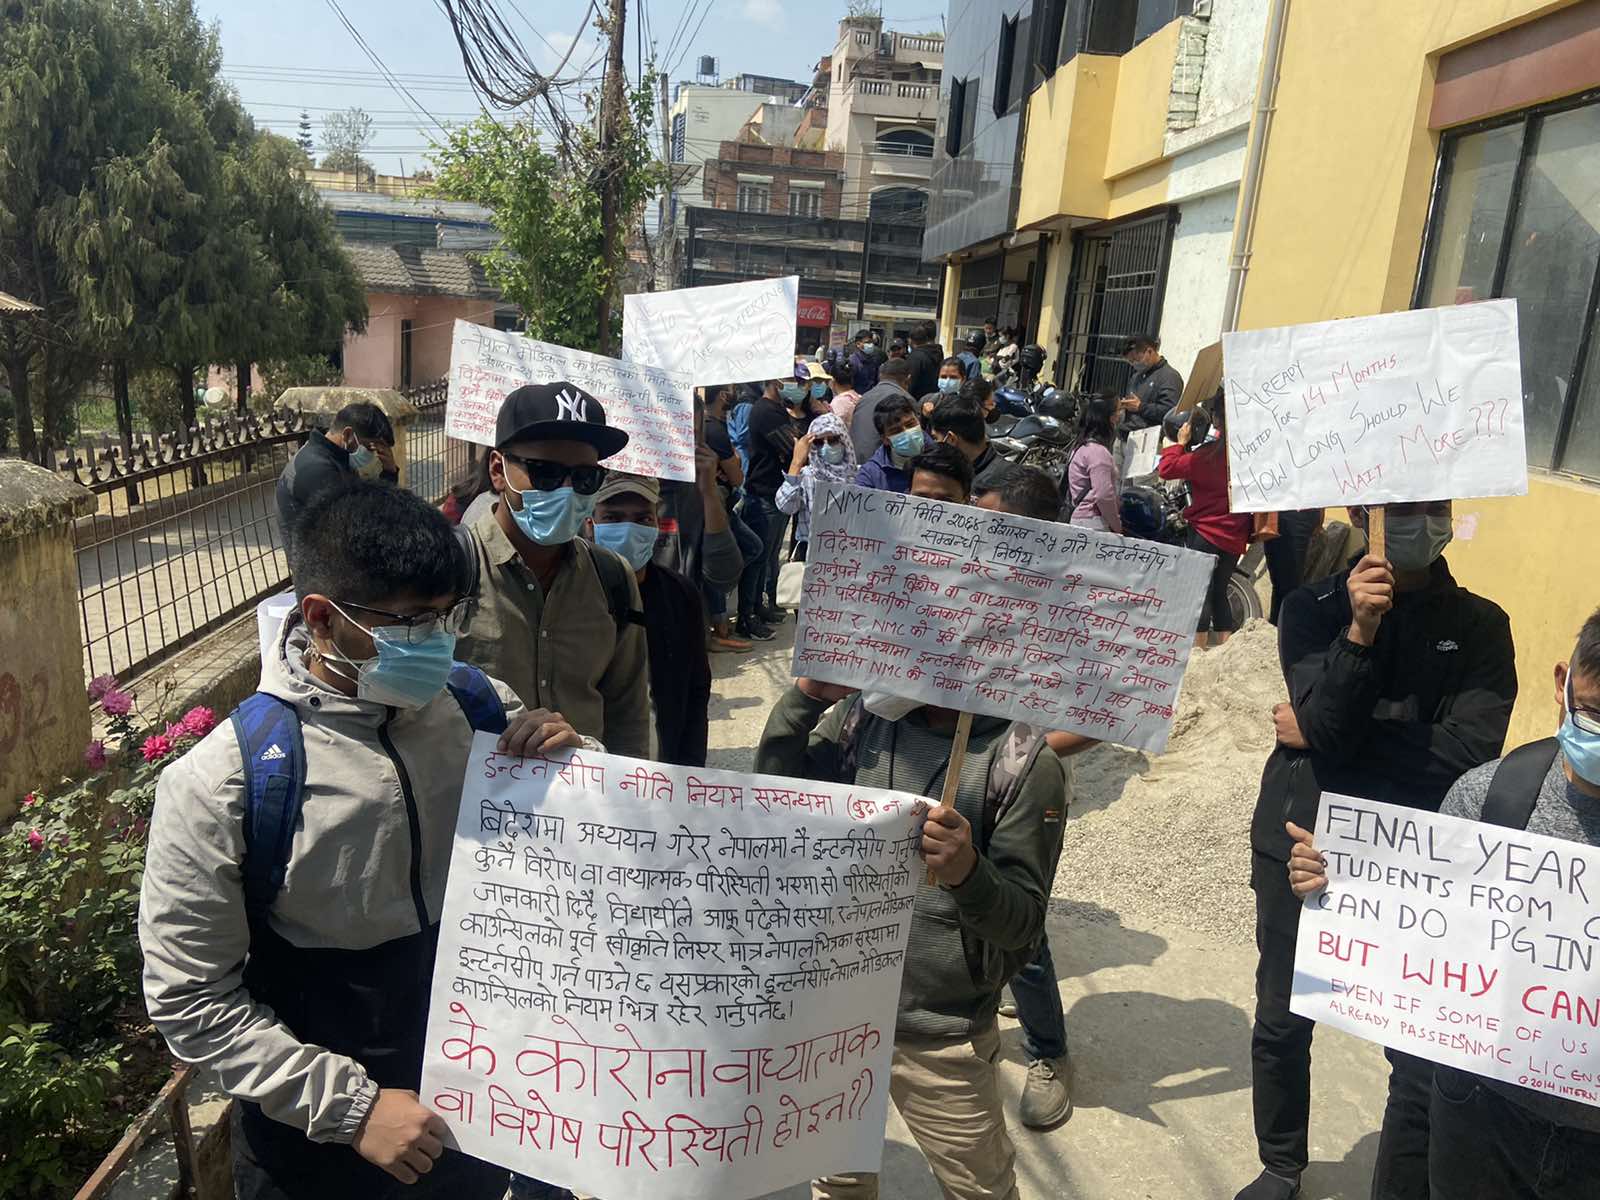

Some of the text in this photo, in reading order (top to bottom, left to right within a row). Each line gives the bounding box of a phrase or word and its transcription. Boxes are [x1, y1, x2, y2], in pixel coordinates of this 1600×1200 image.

[555, 389, 587, 422] NY
[1229, 360, 1305, 418] ALREADY
[1270, 406, 1299, 432] FOR
[1302, 387, 1327, 415] 14
[1331, 354, 1397, 391] MONTHS
[1237, 378, 1461, 503] HOW LONG SHOULD WE
[1332, 460, 1383, 495] WAIT
[824, 489, 876, 516] NMC
[885, 495, 911, 517] को
[913, 503, 947, 524] मिति
[946, 512, 987, 533] २०६४
[1061, 533, 1091, 554] गते
[816, 528, 886, 554] विदेशमा
[891, 545, 957, 570] अध्ययन
[960, 557, 1000, 581] गरेर
[1004, 565, 1056, 589] नेपालमा
[1086, 584, 1167, 616] इन्टर्नसीप
[866, 565, 899, 590] कुनै
[944, 585, 969, 600] वा
[804, 577, 832, 600] सो
[915, 604, 977, 632] जानकारी
[850, 613, 868, 631] र
[872, 619, 905, 637] NMC
[910, 620, 934, 640] को
[1076, 657, 1121, 681] मात्र
[1122, 664, 1173, 693] नेपाल
[870, 660, 902, 680] NMC
[906, 666, 928, 682] को
[932, 671, 972, 693] नियम
[260, 752, 287, 761] adidas
[619, 766, 674, 804] नीति
[686, 775, 744, 812] नियम
[474, 841, 517, 873] कुनै
[523, 845, 577, 884] विशेष
[580, 862, 603, 885] वा
[819, 866, 838, 896] सो
[577, 821, 658, 855] अध्ययन
[666, 824, 713, 864] गरेर
[718, 826, 788, 861] नेपालमा
[790, 826, 811, 860] नै
[812, 826, 888, 862] इन्टर्नसीप
[1326, 803, 1590, 905] FINAL YEAR
[473, 881, 560, 917] जानकारी
[1469, 884, 1552, 922] FROM
[459, 907, 565, 949] काउन्सिलको
[569, 922, 598, 957] पूर्व
[672, 931, 726, 964] लिएर
[728, 941, 765, 962] मात्र
[764, 932, 815, 960] नेपाल
[813, 931, 854, 956] भित्रका
[854, 923, 901, 950] संस्थामा
[1318, 890, 1381, 922] CAN
[1398, 904, 1448, 939] DO
[1490, 919, 1536, 964] PG
[458, 943, 544, 981] इन्टर्नसीप
[550, 956, 581, 988] गर्न
[585, 960, 632, 993] पाउने
[634, 972, 654, 992] छ
[658, 971, 692, 997] यस
[762, 960, 830, 995] इन्टर्नसीप
[829, 957, 861, 983] नेपाल
[860, 949, 904, 976] मेडिकल
[1318, 930, 1380, 968] BUT
[1401, 952, 1499, 998] WHY
[452, 974, 558, 1014] काउन्सिलको
[563, 988, 613, 1023] नियम
[618, 993, 660, 1022] भित्र
[666, 995, 709, 1028] रहेर
[1329, 999, 1390, 1030] ALREADY
[1330, 978, 1589, 1055] EVEN IF SOME OF US
[441, 1001, 882, 1102] के कोरोना वाध्यात्मक
[434, 1084, 475, 1126] वा
[487, 1083, 584, 1160] विशेष
